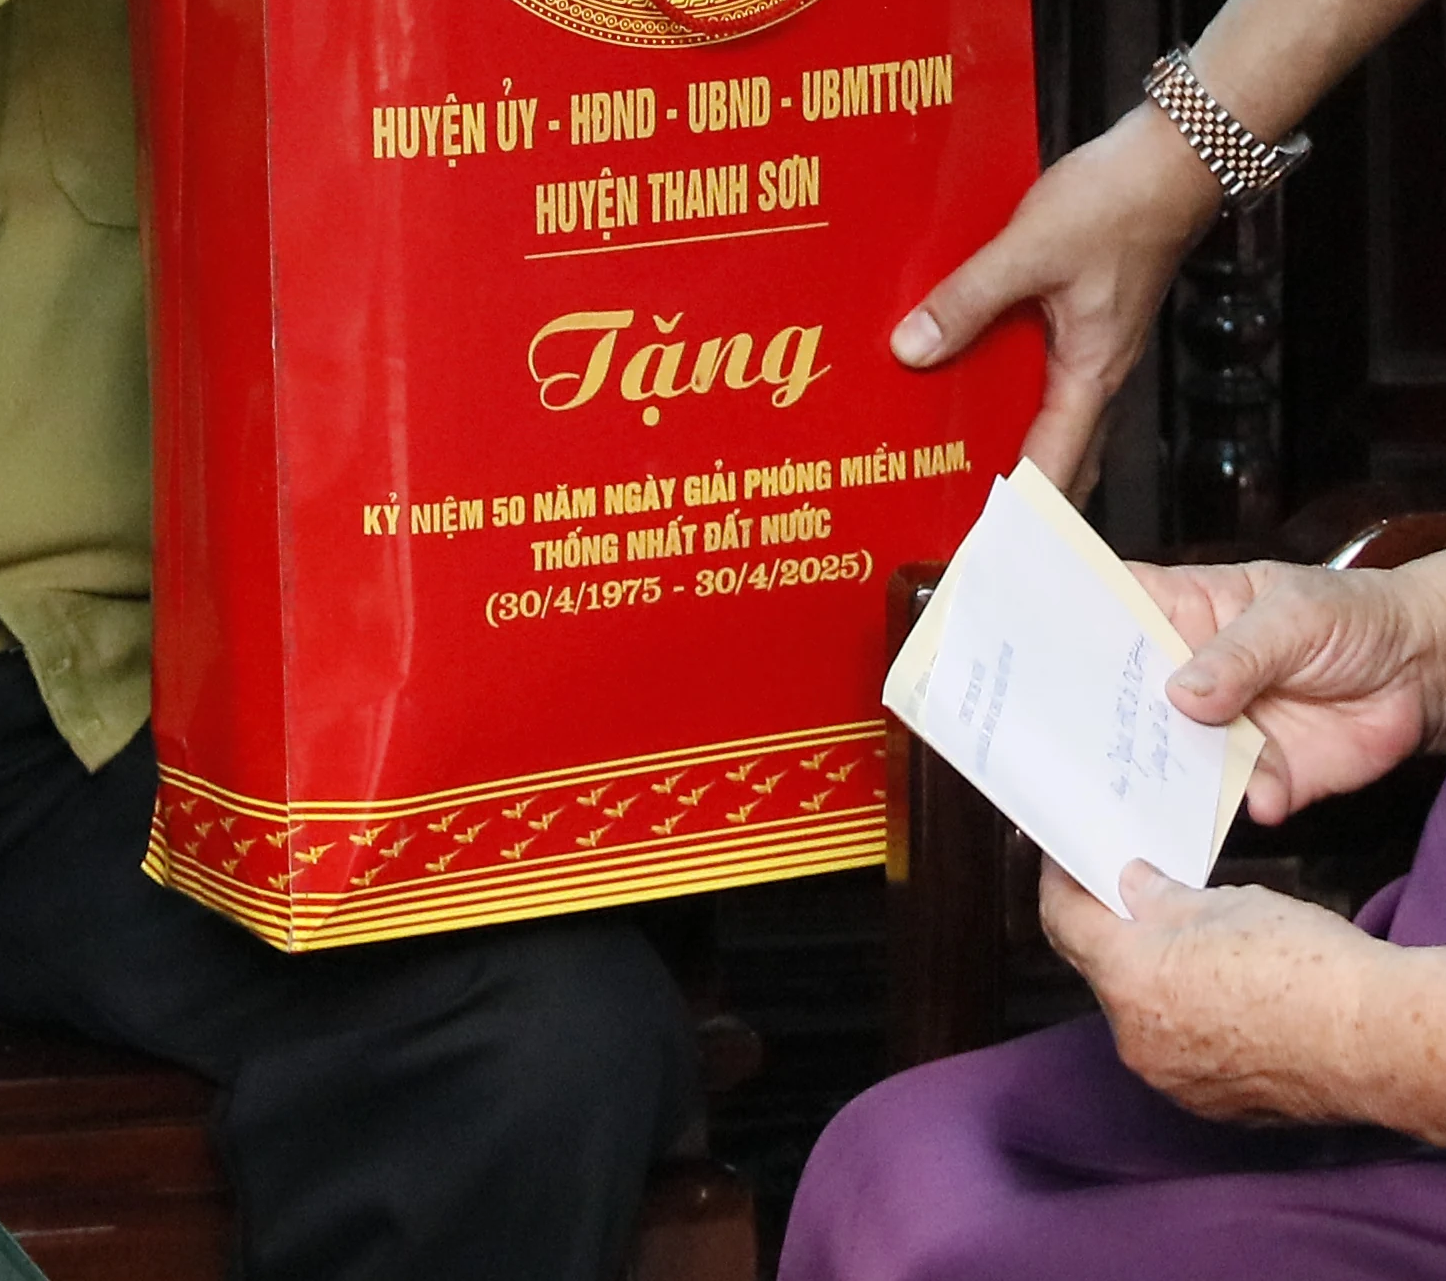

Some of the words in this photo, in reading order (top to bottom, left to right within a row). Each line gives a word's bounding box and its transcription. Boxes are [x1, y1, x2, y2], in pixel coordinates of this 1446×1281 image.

[373, 92, 486, 168] HUYỆN
[496, 77, 538, 152] ỦY
[570, 87, 656, 145] HĐND
[688, 76, 771, 134] UBND
[802, 54, 953, 122] UBMTTQVN
[536, 166, 638, 240] HUYỆN
[648, 164, 748, 223] THANH
[758, 154, 820, 212] SƠN
[527, 309, 832, 427] Tặng
[363, 492, 401, 536] KỶ
[410, 496, 484, 539] NIỆM
[492, 495, 525, 527] 50
[533, 484, 597, 523] NĂM
[604, 473, 677, 516] NGÀY
[683, 458, 737, 507] GIẢI
[743, 458, 832, 500] PHÓNG
[840, 442, 906, 488] MIỀN
[913, 440, 972, 479] NAM,
[530, 526, 619, 572] THỐNG
[626, 515, 698, 561] NHẤT
[703, 508, 754, 553] ĐẤT
[761, 502, 832, 546] NƯỚC
[485, 576, 663, 628] (30/4/1975
[695, 549, 874, 598] 30/4/2025)
